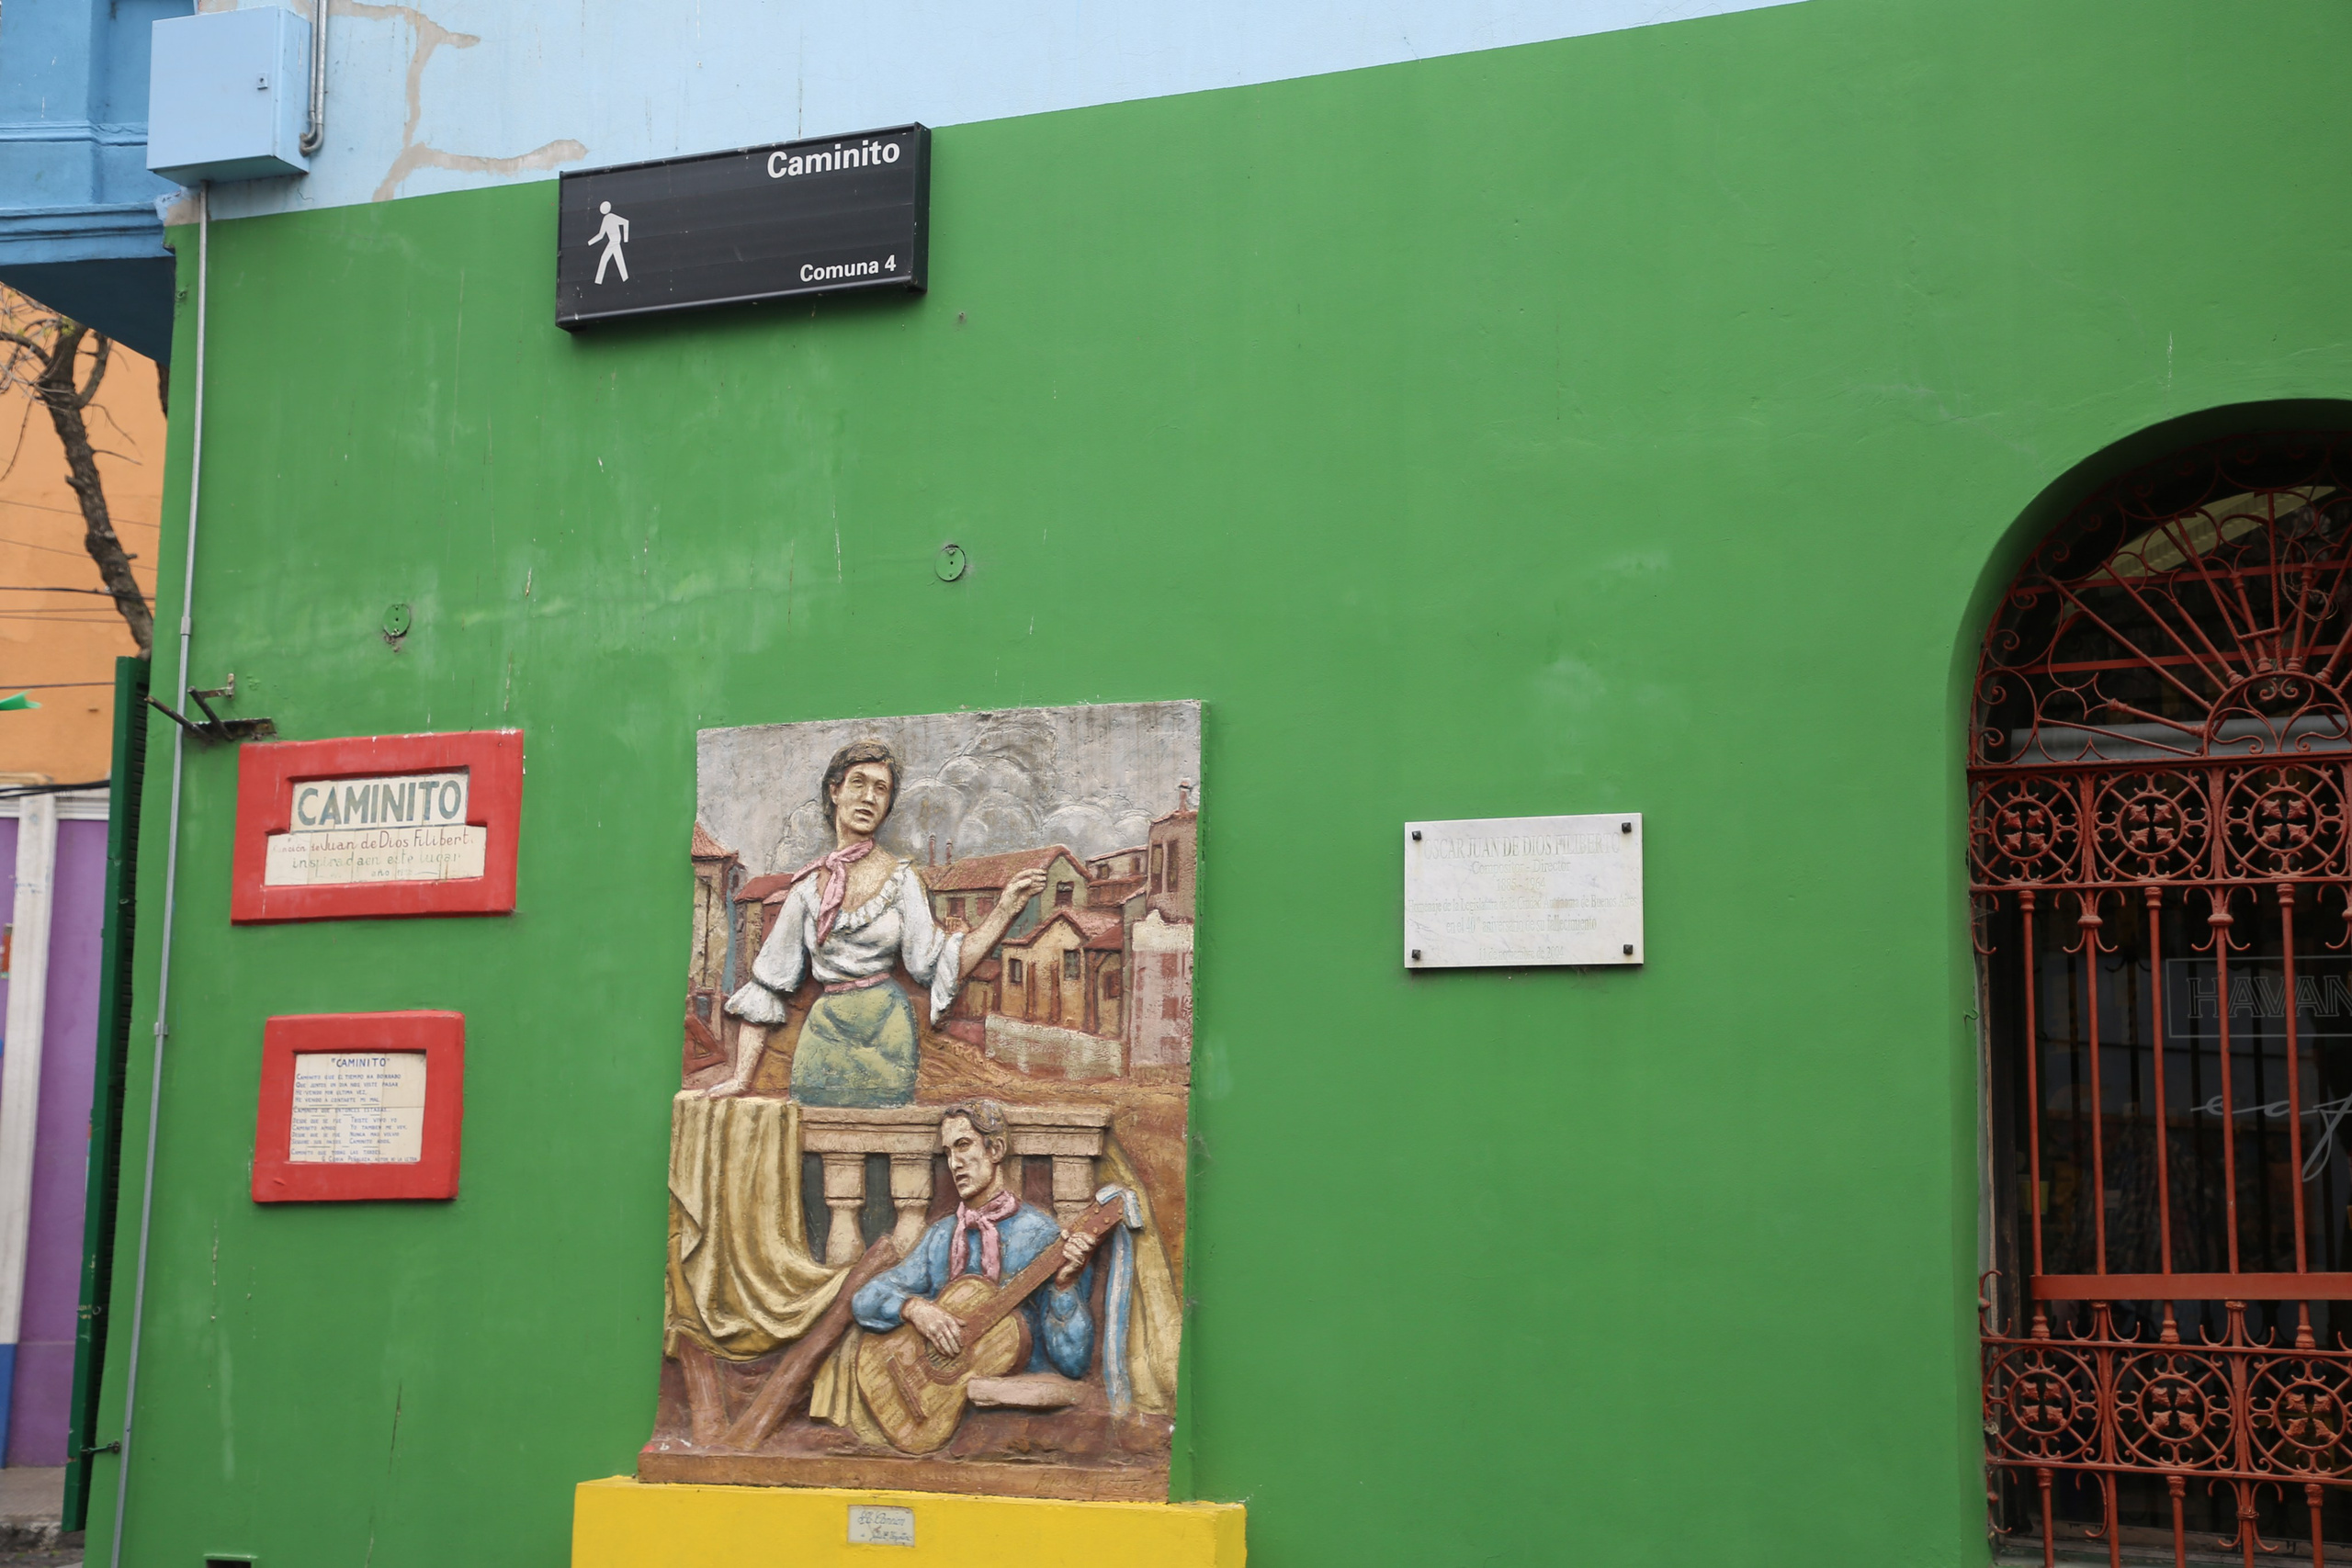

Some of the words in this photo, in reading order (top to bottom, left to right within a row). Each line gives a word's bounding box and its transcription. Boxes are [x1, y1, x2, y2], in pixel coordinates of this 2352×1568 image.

[767, 140, 900, 179] Caminito
[800, 259, 878, 282] Comuna
[885, 254, 897, 272] 4
[298, 780, 461, 826] CAMINITO
[321, 833, 356, 852] Juan
[361, 832, 377, 850] de
[379, 829, 409, 849] Dios
[1424, 837, 1465, 860] OSCAR
[1467, 837, 1500, 858] JUAN
[1503, 836, 1520, 857] DE
[1522, 834, 1552, 856] DIOS
[1555, 831, 1621, 855] FILIBERTO
[1471, 860, 1525, 876] Compositor
[1532, 859, 1571, 873] Director
[1525, 877, 1546, 891] 1964
[1408, 898, 1442, 915] Homenaje
[1443, 898, 1452, 911] de
[1499, 897, 1508, 910] de
[1580, 895, 1589, 908] de
[1590, 894, 1617, 908] Buenos
[1618, 893, 1638, 908] Aires
[1446, 921, 1455, 934] en
[1457, 918, 1464, 933] el
